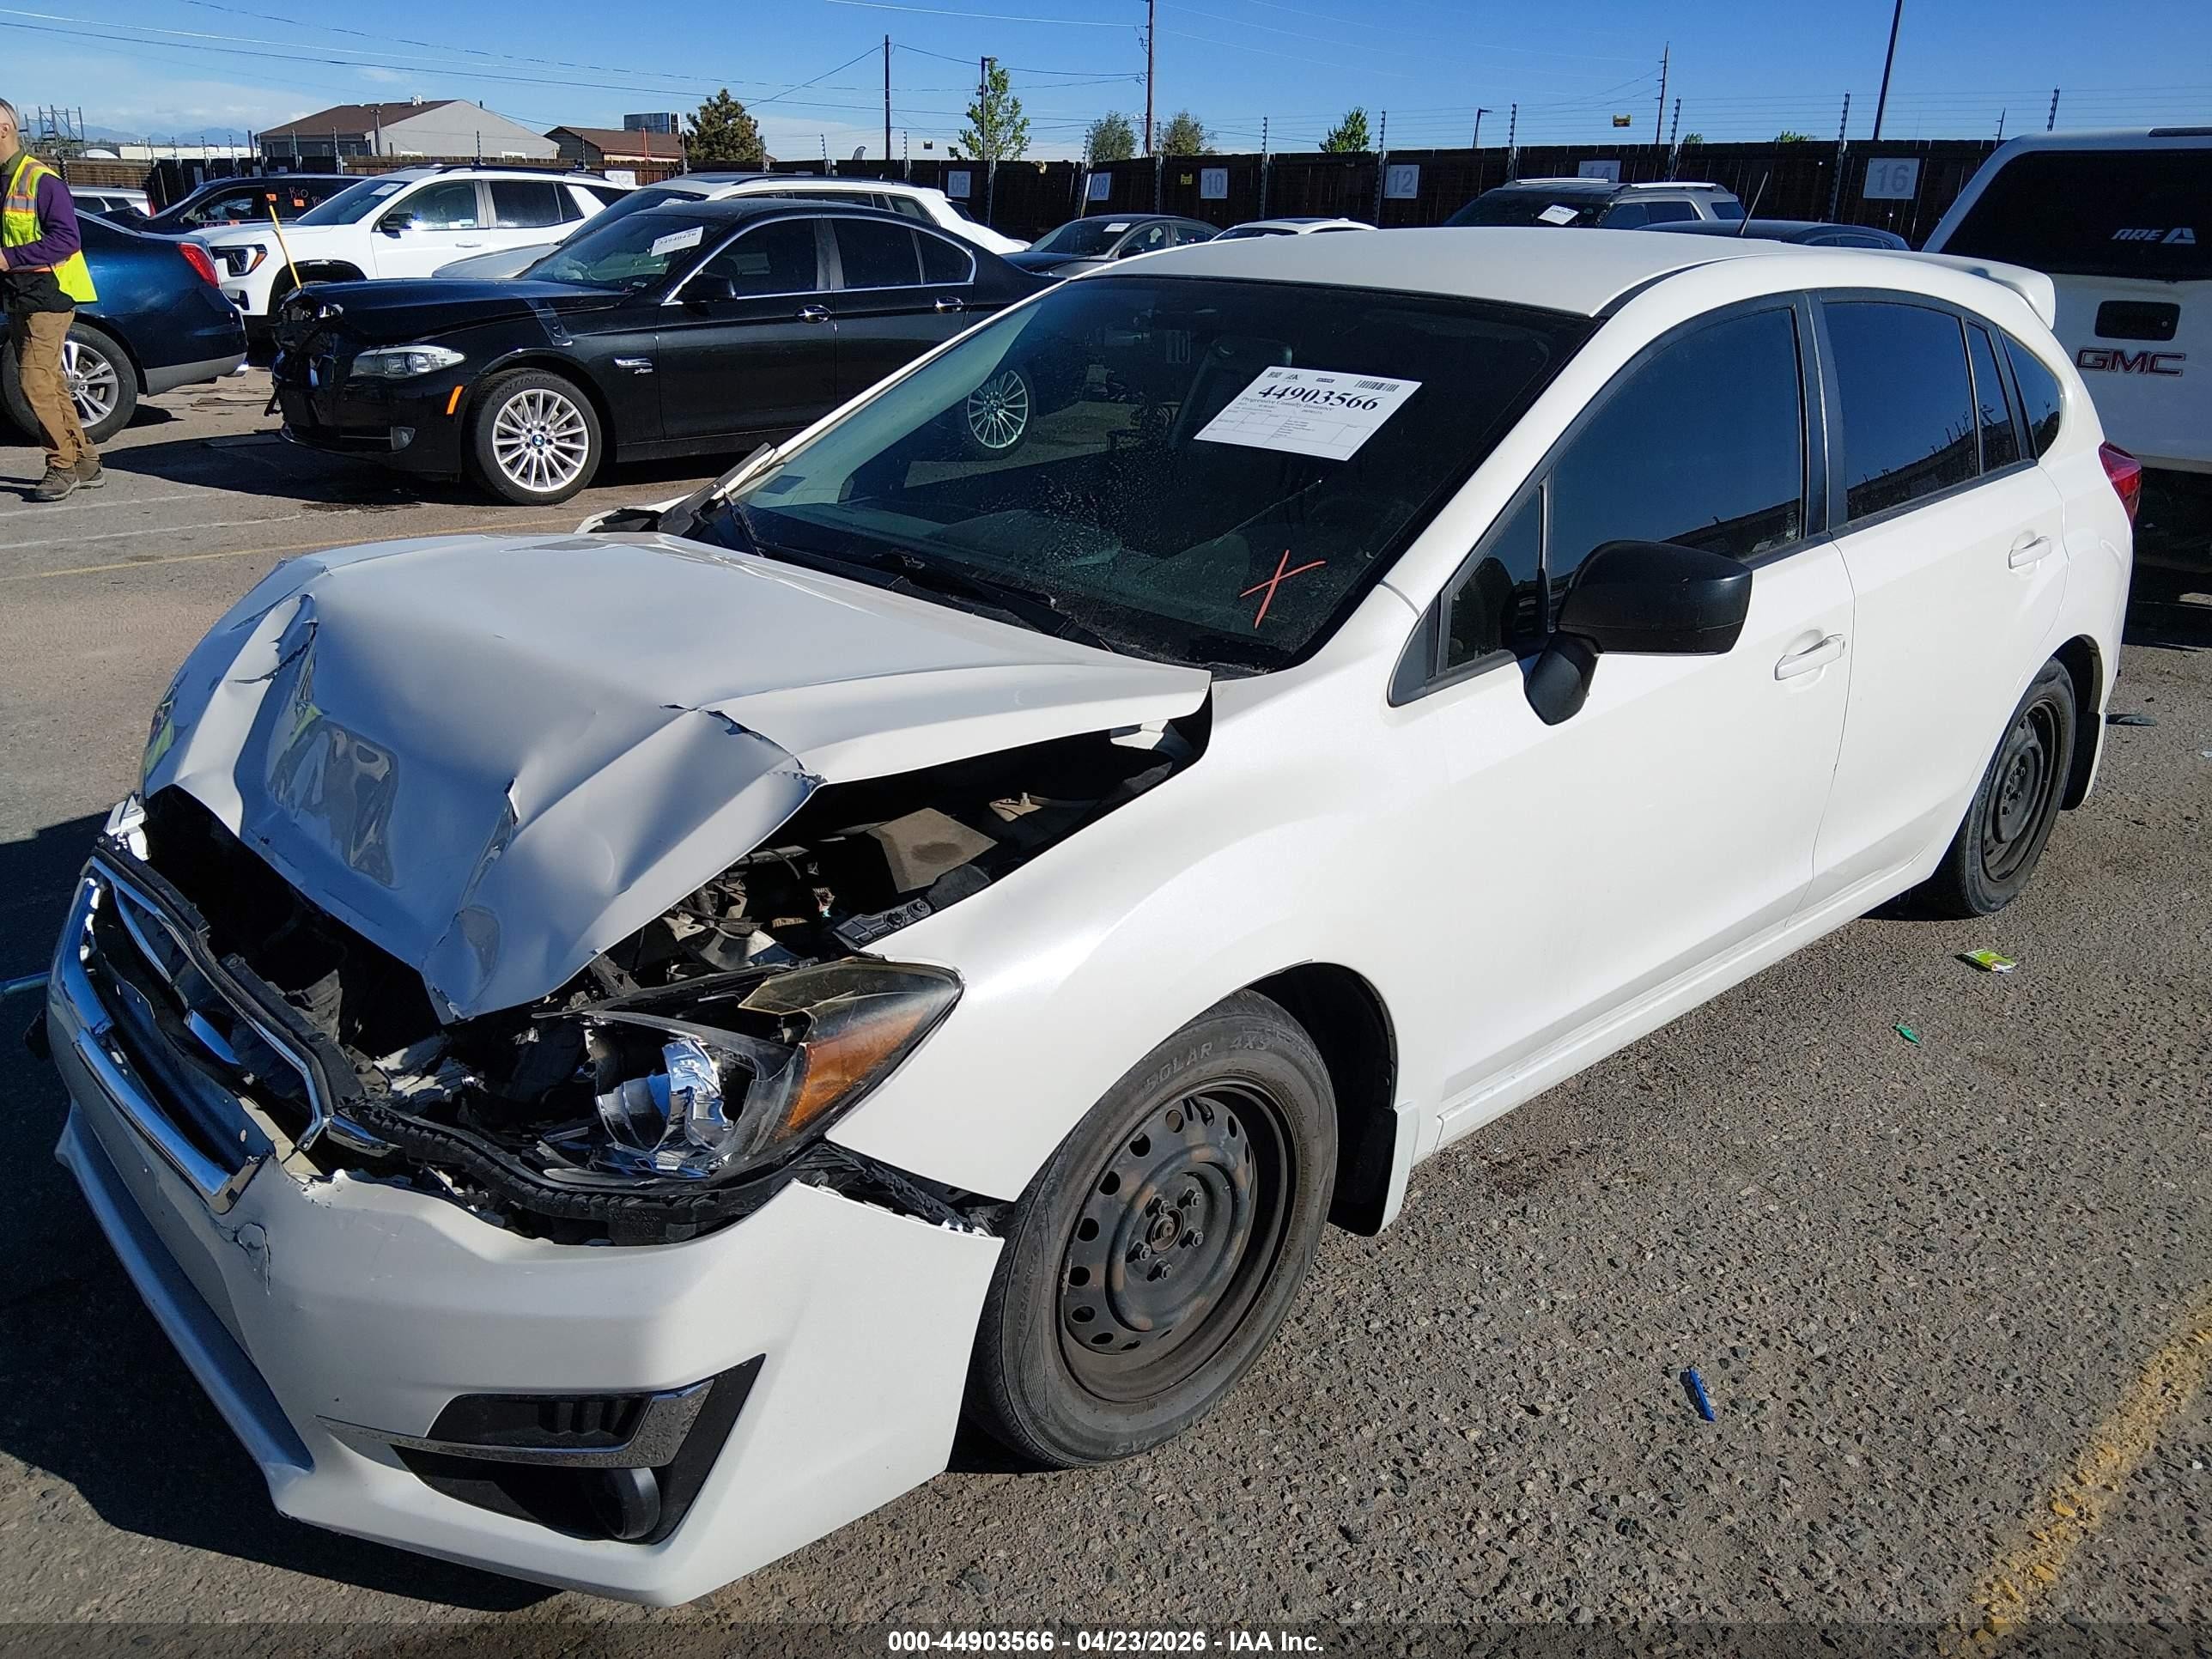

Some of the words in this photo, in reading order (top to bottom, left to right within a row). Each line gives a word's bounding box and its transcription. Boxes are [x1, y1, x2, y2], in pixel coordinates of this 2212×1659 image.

[951, 174, 967, 193] 06
[1093, 177, 1108, 197] 08
[1206, 172, 1224, 194] 10
[1393, 170, 1414, 193] 12
[1876, 163, 1910, 193] 16
[2111, 228, 2165, 241] ARE
[2076, 347, 2187, 378] GMC
[1258, 384, 1386, 411] 44903566
[1140, 1042, 1213, 1096] SOLAR
